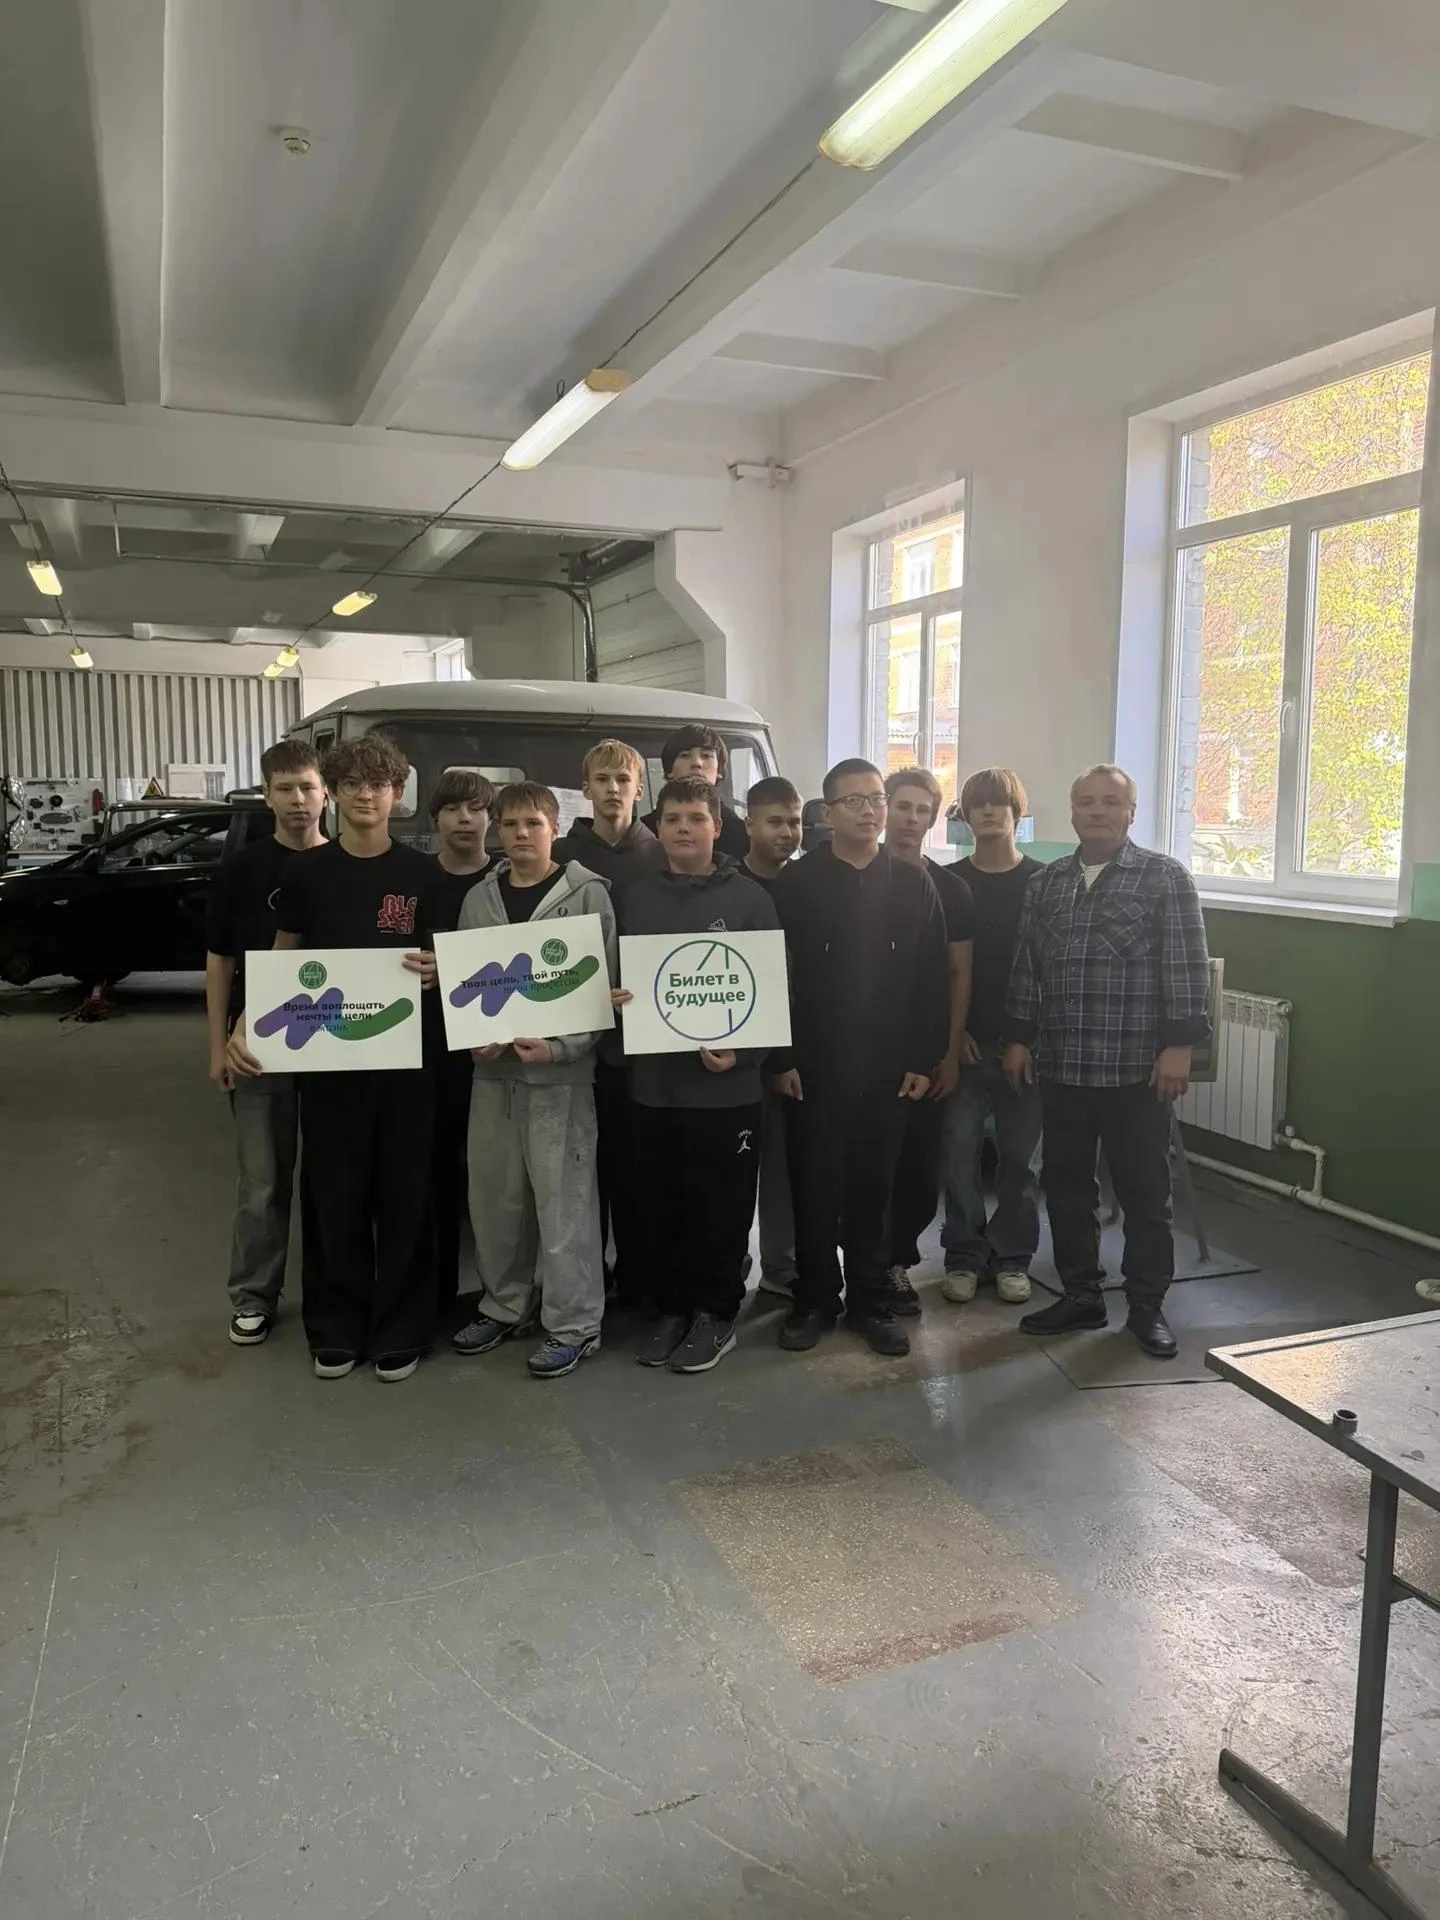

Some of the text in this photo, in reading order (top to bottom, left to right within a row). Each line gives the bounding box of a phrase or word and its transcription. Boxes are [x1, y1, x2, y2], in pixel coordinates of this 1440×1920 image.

[461, 980, 487, 989] Твоя
[490, 977, 520, 987] цель,
[522, 970, 548, 981] твой
[669, 973, 739, 988] Билет в
[664, 989, 746, 1008] будущее
[283, 1001, 386, 1013] Время воплощать
[296, 1012, 373, 1022] мечты и цели
